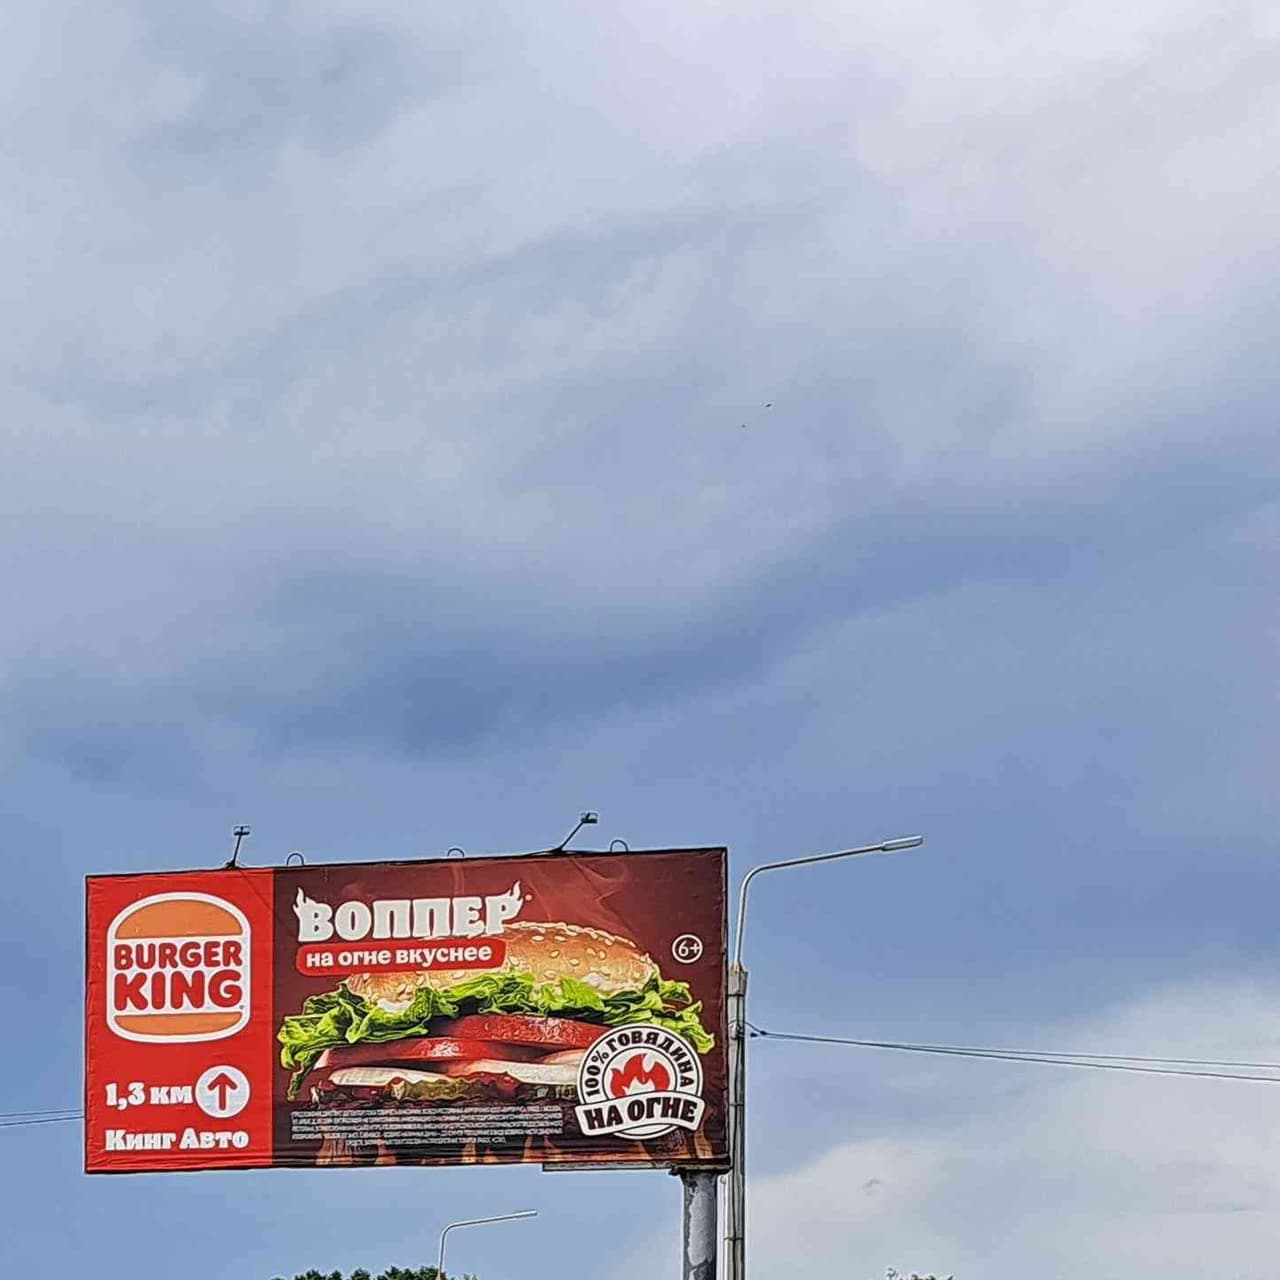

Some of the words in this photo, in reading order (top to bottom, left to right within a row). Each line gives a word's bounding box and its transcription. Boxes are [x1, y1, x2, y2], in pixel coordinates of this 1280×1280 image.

[293, 882, 523, 942] ВОППЕР
[114, 941, 243, 970] BURGER
[306, 952, 333, 967] на
[340, 950, 391, 967] огне
[396, 946, 492, 969] вкуснее
[678, 940, 701, 957] 6+
[114, 969, 243, 1011] KING
[584, 1050, 610, 1098] 100%
[606, 1030, 694, 1088] ГОВЯДИНА
[105, 1082, 145, 1110] 1,3
[150, 1086, 193, 1105] км
[584, 1105, 623, 1130] НА
[627, 1096, 698, 1123] ОГНЕ
[105, 1129, 176, 1151] Кинг
[179, 1128, 249, 1149] Авто
